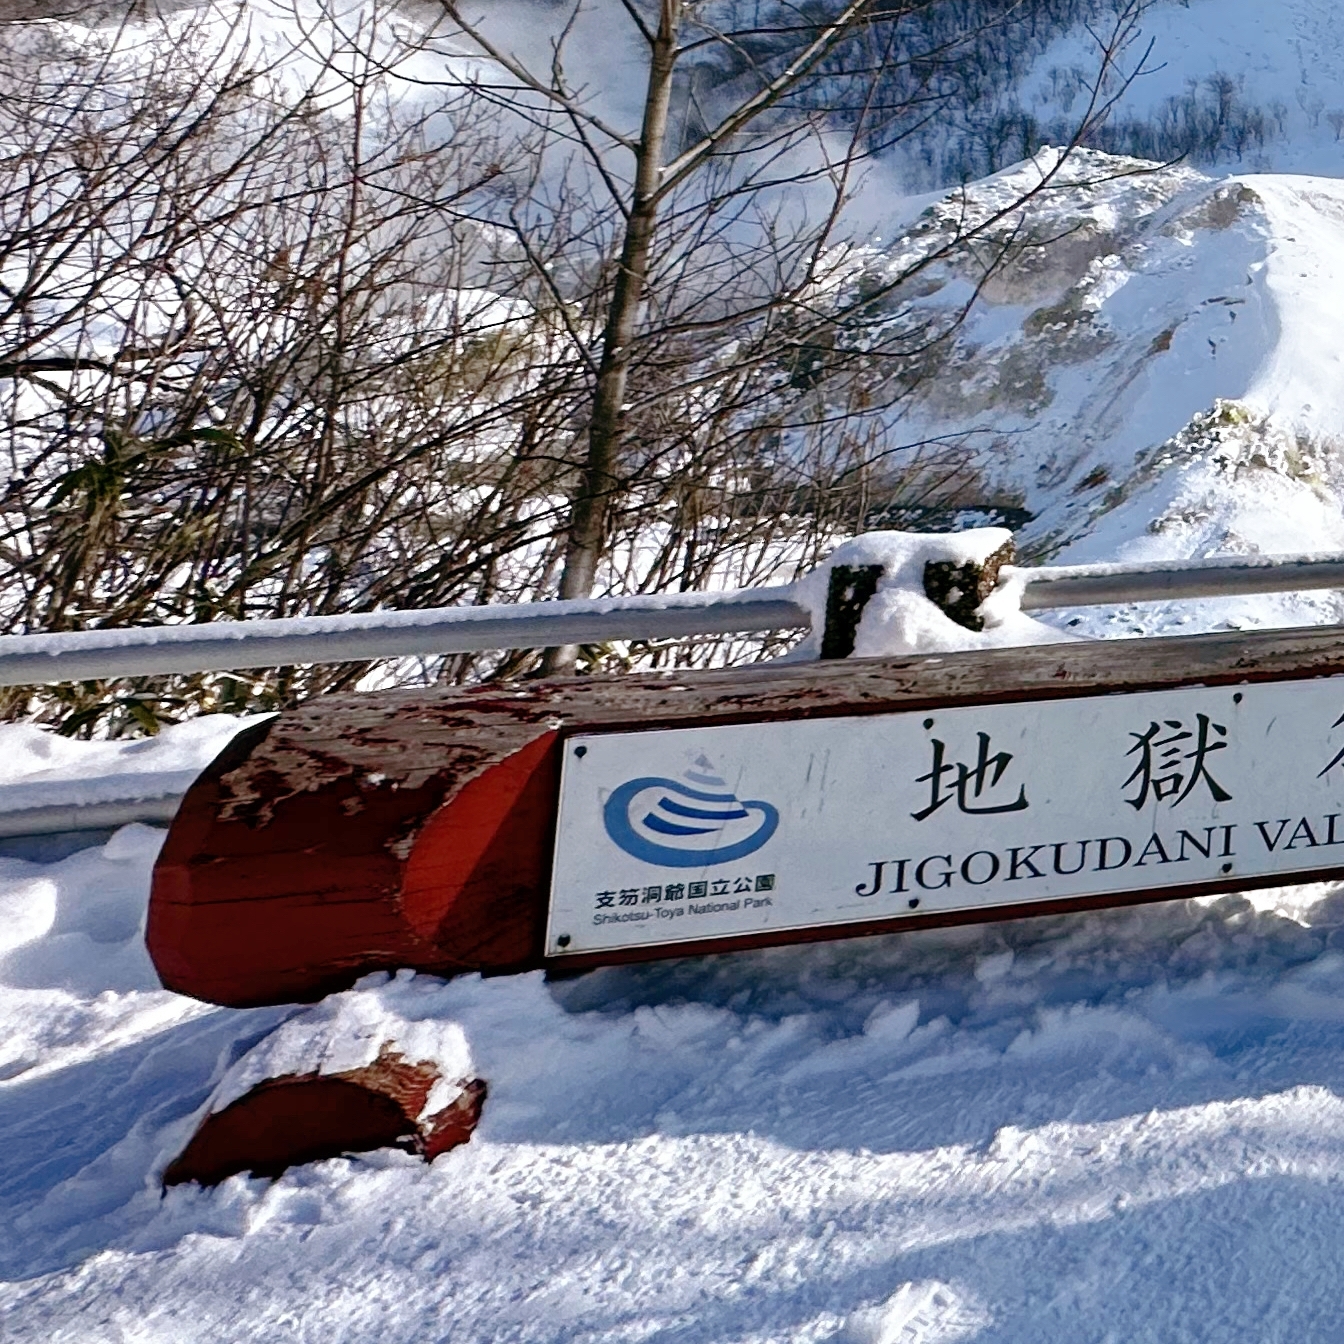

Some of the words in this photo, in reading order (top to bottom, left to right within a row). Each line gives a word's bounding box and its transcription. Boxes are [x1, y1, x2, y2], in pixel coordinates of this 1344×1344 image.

[855, 824, 1239, 897] JIGOKUDANI
[592, 906, 685, 926] Shikotsu-Toya
[688, 899, 741, 916] National
[744, 896, 774, 909] Park
